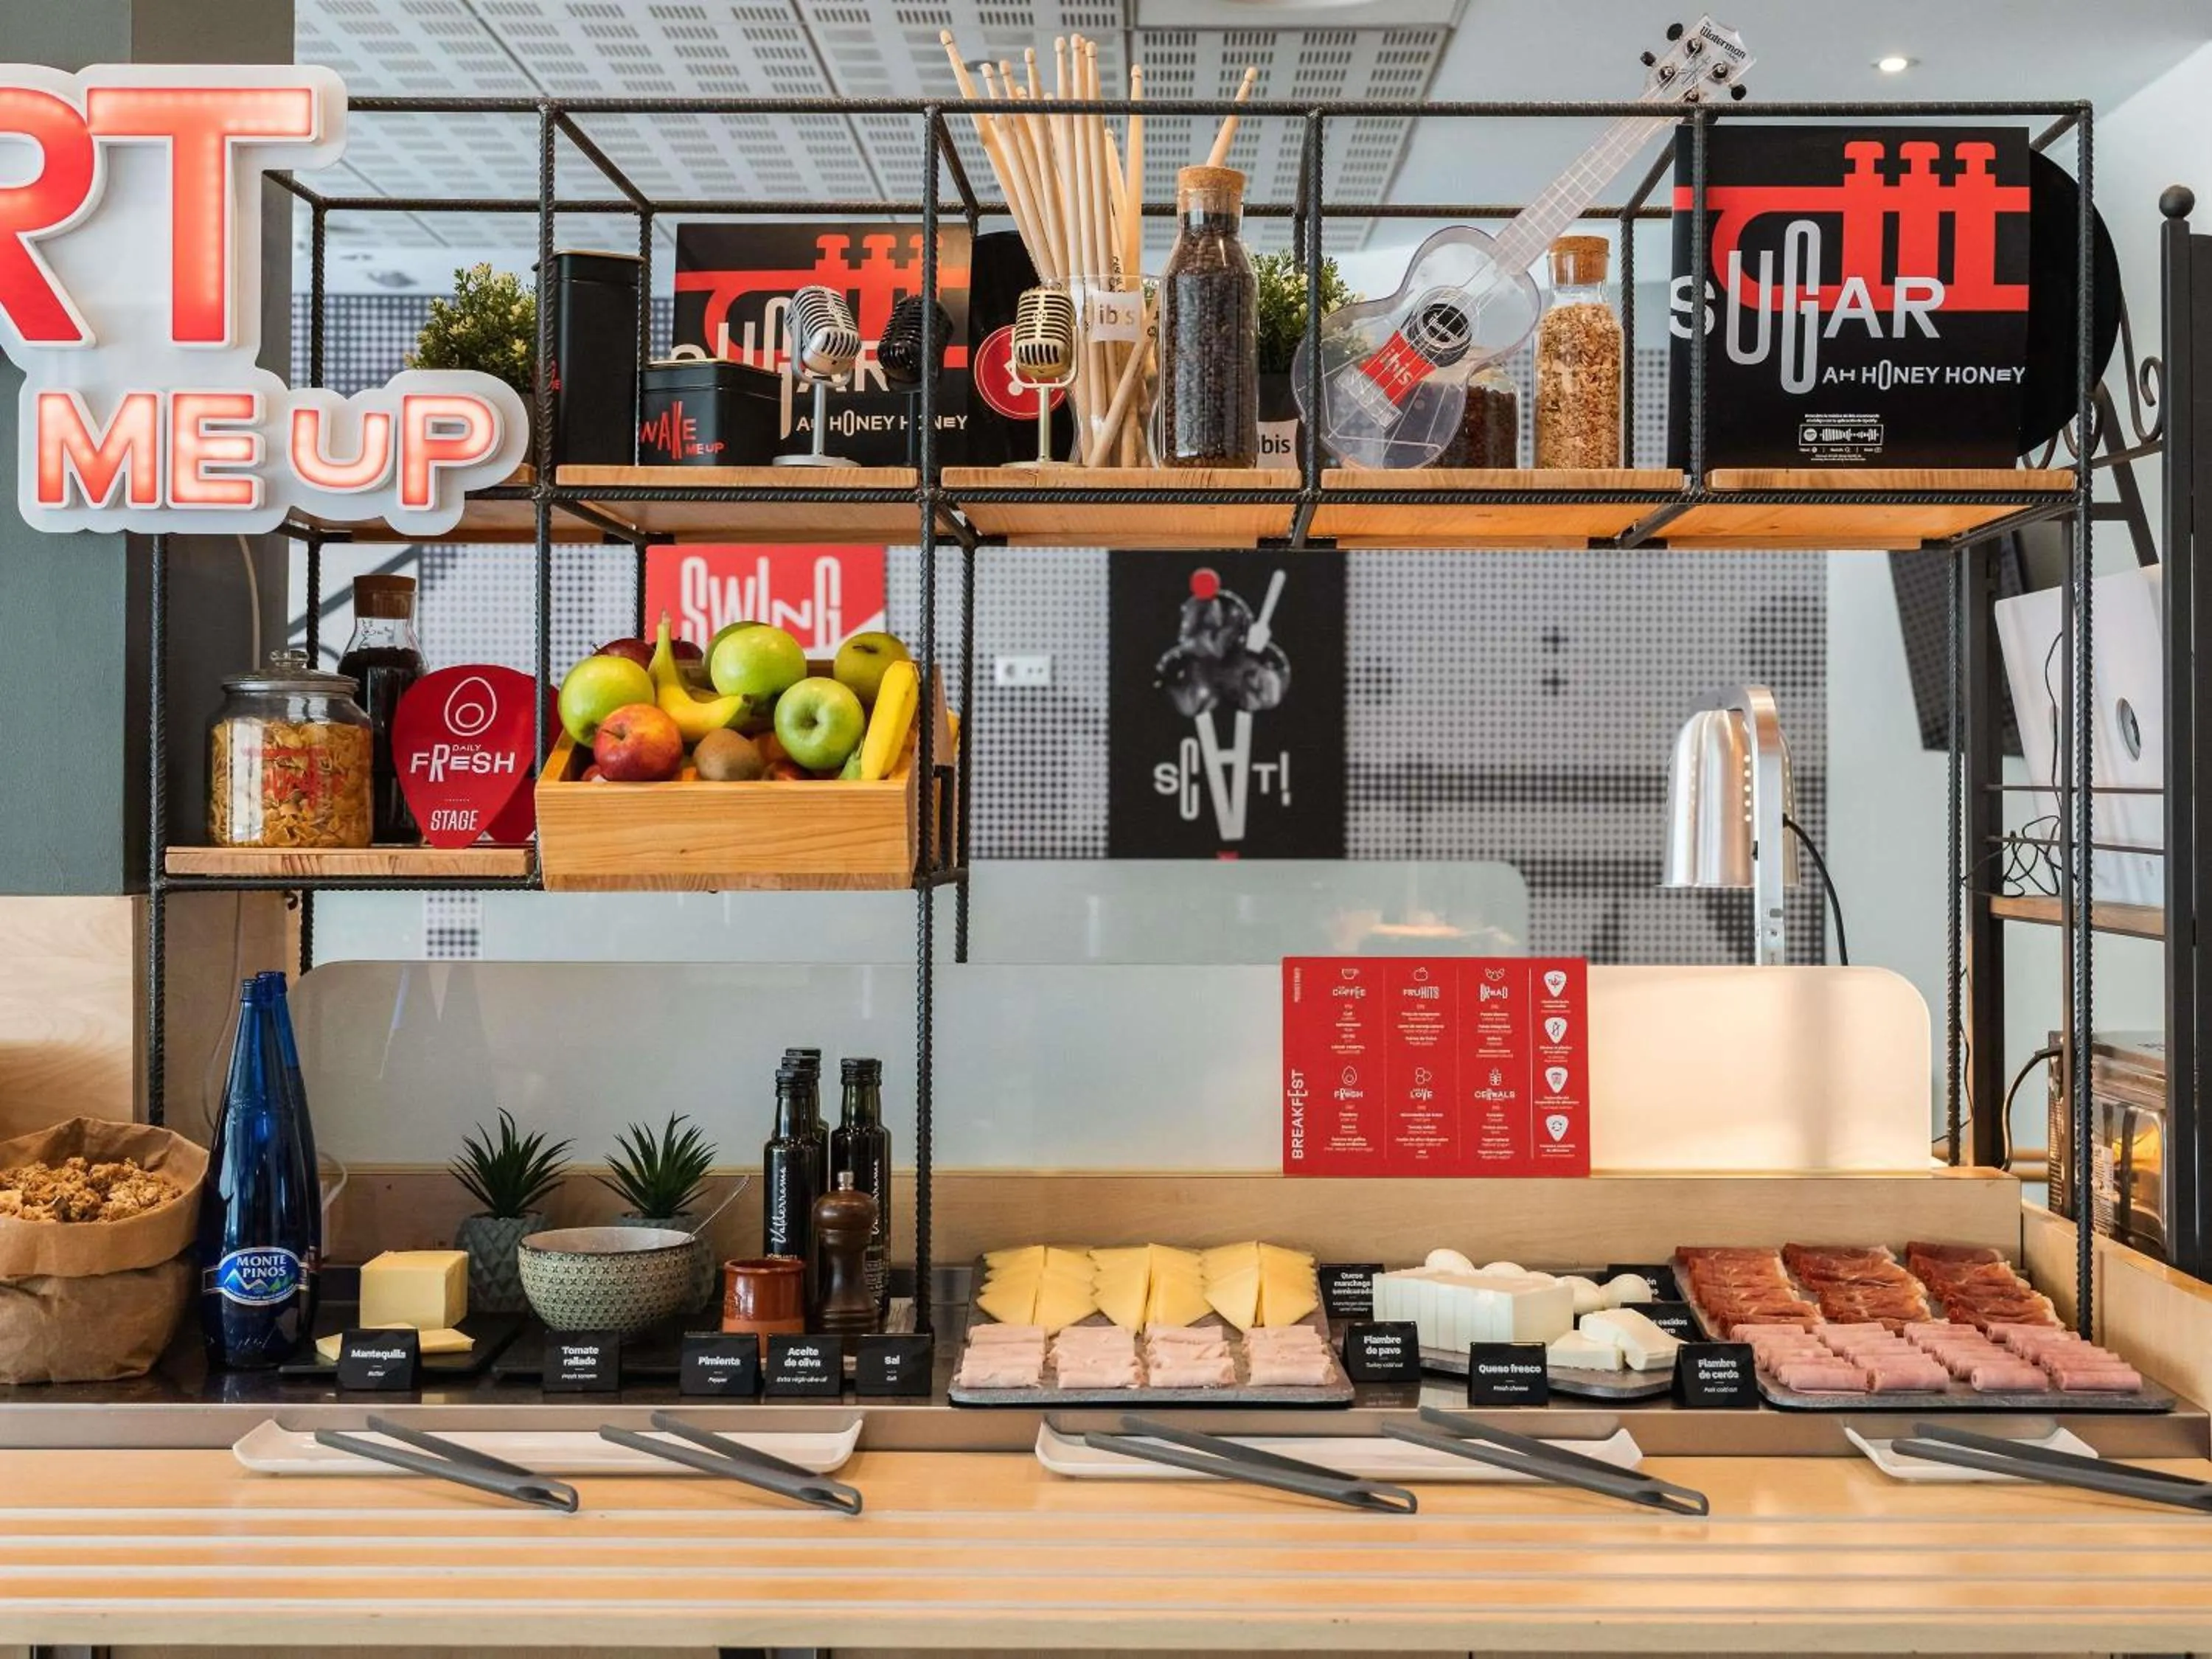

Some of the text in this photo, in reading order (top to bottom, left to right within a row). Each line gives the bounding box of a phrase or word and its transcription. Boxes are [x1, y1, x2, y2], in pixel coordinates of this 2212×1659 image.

[1669, 219, 1946, 394] SUGAR
[1822, 359, 2026, 391] AH HONEY HONEY
[830, 410, 896, 437] HONEY
[38, 393, 255, 504] ME
[681, 556, 841, 653] SWING
[452, 743, 481, 752] DAILY
[410, 744, 516, 783] FRESH
[430, 809, 479, 831] STAGE
[236, 1254, 287, 1267] MONTE
[243, 1266, 287, 1279] PINOS
[561, 1346, 599, 1355] Tomate
[787, 1346, 820, 1356] Aceite
[1366, 1346, 1402, 1357] de pavo
[563, 1356, 597, 1366] rallado
[784, 1357, 821, 1368] de oliva
[884, 1354, 901, 1365] Sal
[1478, 1363, 1543, 1374] Queso fresco
[1698, 1368, 1740, 1380] de cerdo
